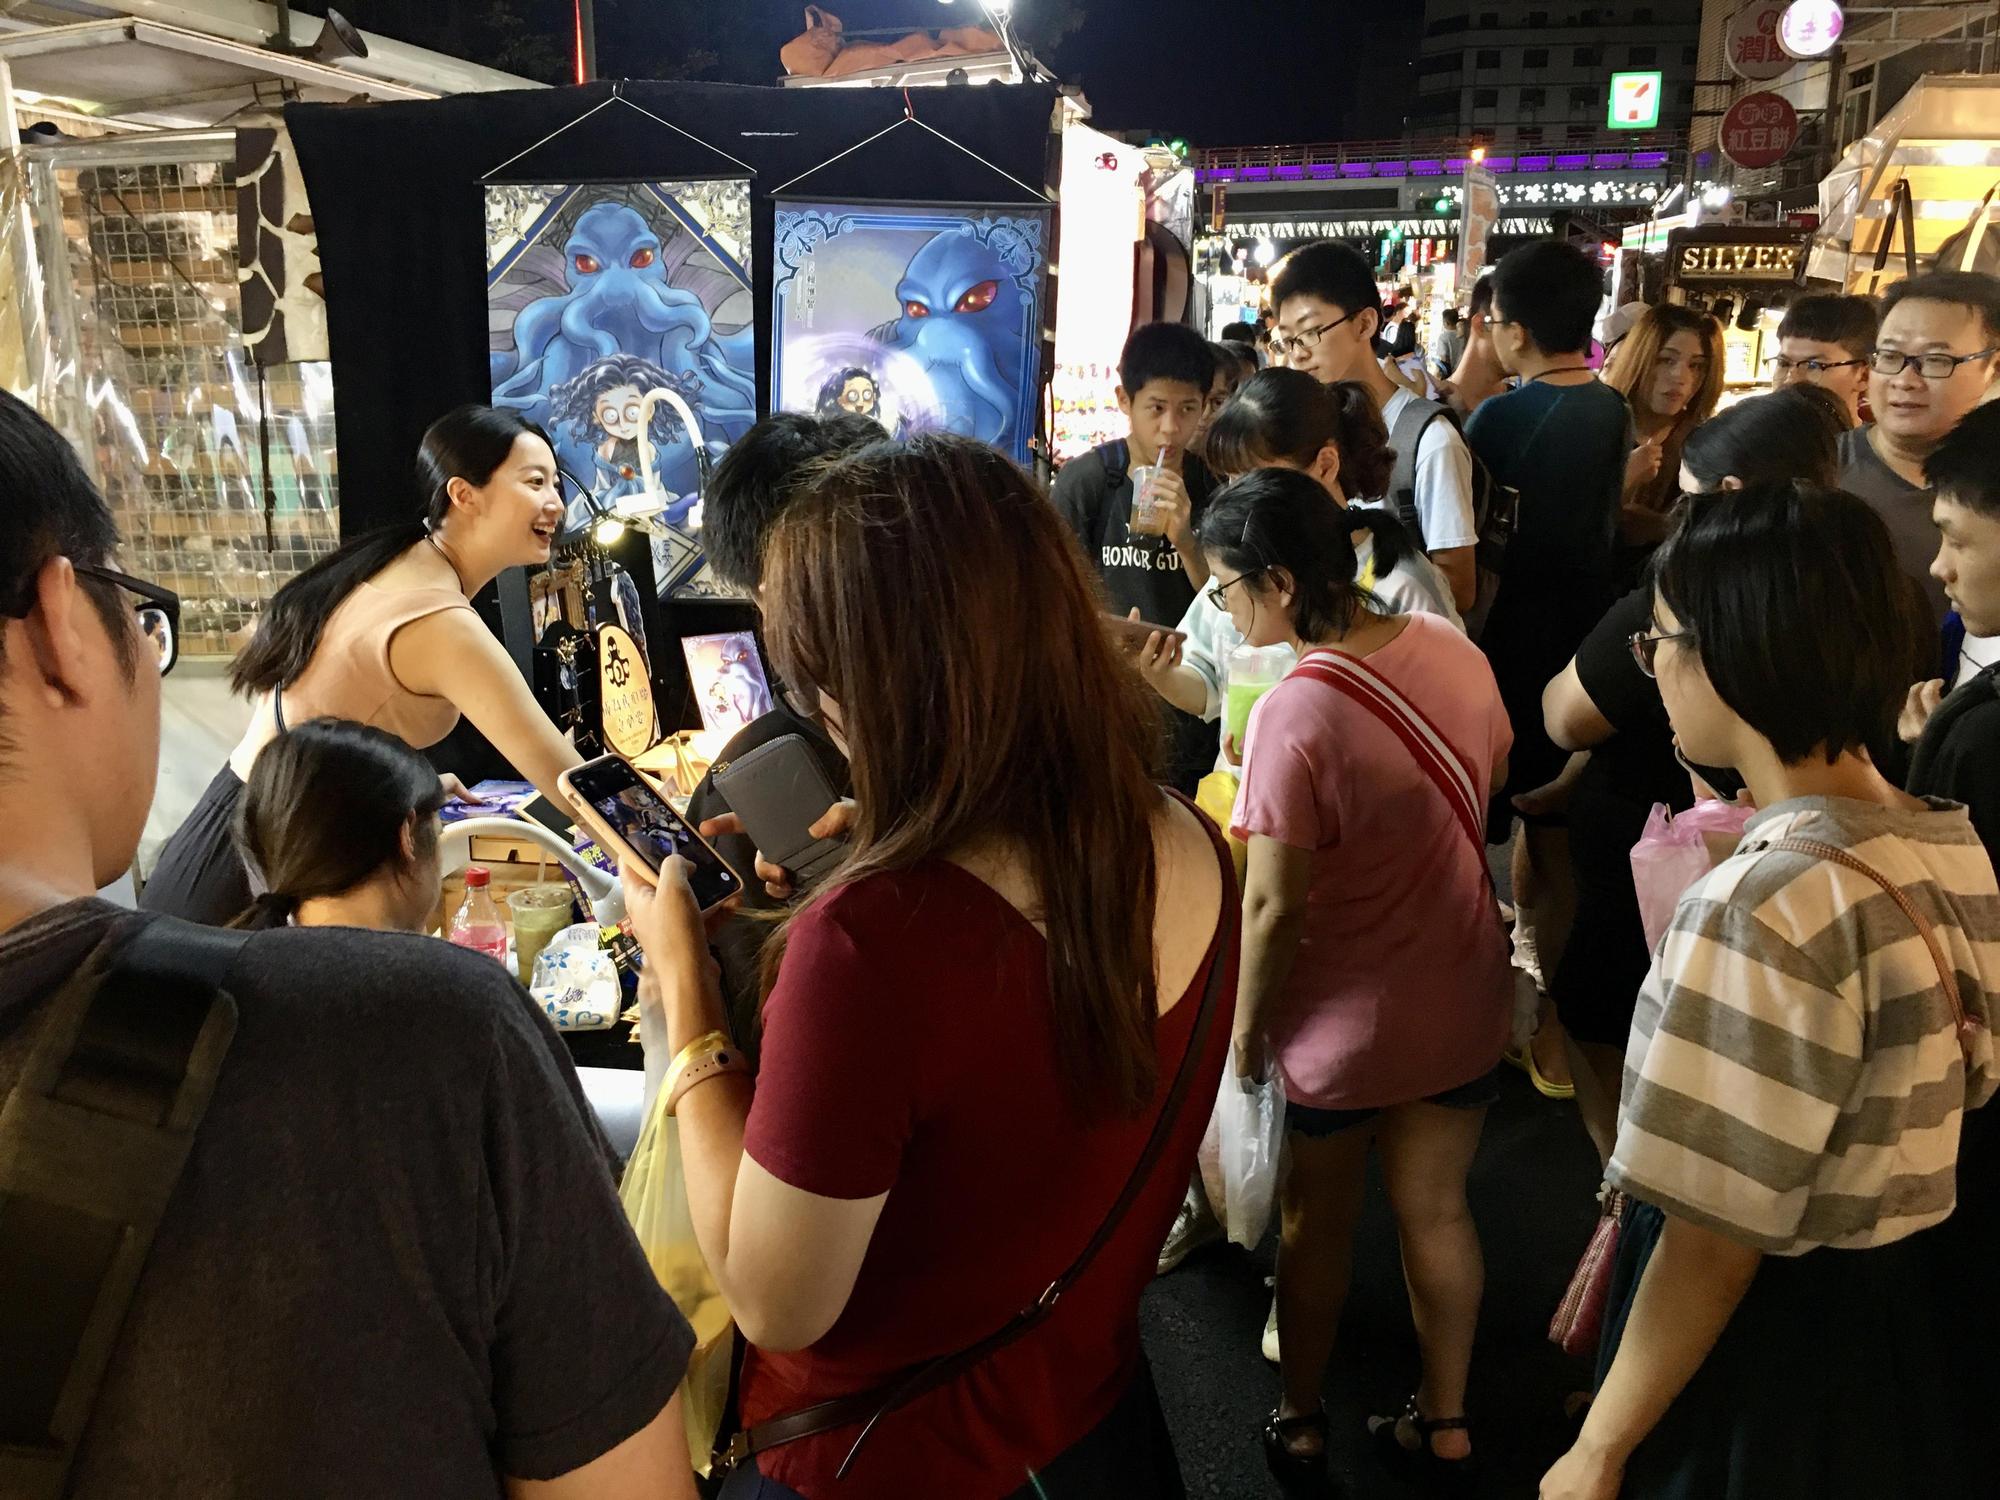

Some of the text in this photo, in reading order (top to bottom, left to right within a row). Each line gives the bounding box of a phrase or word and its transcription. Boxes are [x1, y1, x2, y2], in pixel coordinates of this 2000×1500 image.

[1728, 127, 1790, 152] 紅豆餅
[1681, 246, 1794, 271] SILVER
[1102, 546, 1185, 571] HONOR GU
